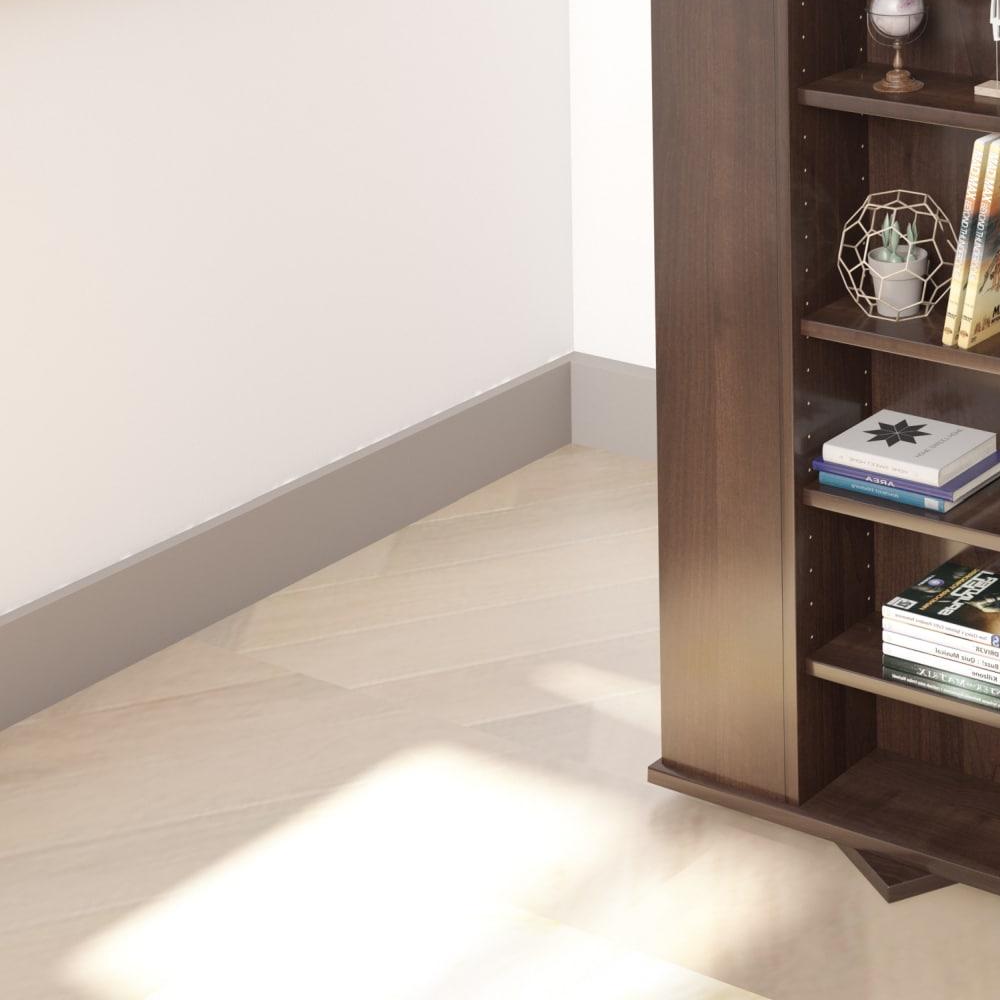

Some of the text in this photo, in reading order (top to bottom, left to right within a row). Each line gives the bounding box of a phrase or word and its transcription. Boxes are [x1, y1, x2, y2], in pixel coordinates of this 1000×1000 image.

[988, 152, 1000, 176] MAD
[966, 176, 980, 200] MAX
[981, 178, 995, 202] MAX
